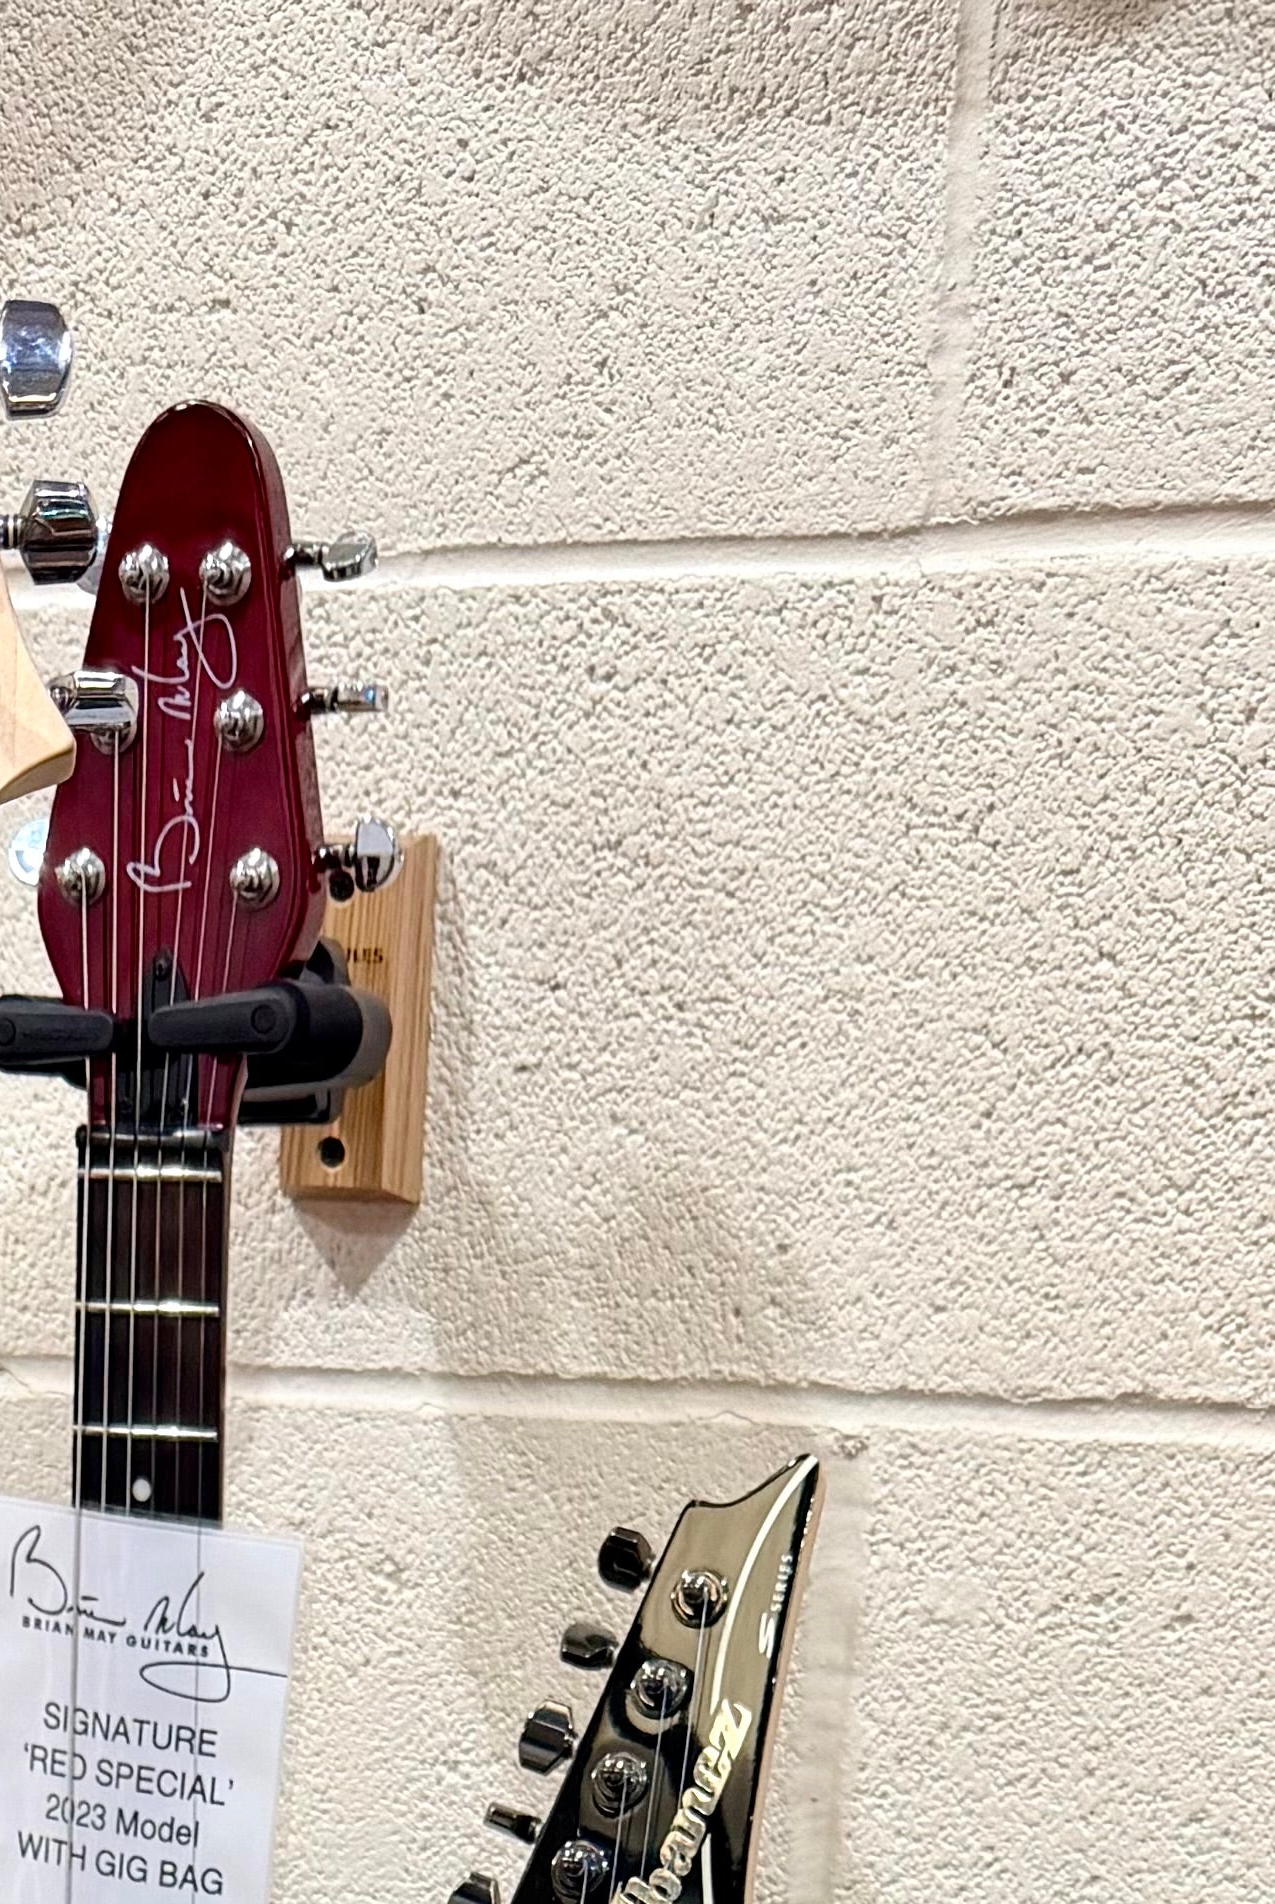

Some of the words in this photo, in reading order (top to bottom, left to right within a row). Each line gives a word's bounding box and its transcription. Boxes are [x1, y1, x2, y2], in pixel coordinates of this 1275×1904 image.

[770, 1553, 793, 1612] SERIES
[22, 1615, 75, 1637] BRIAN
[83, 1626, 117, 1645] MAY
[126, 1635, 210, 1658] GUITARS
[43, 1702, 218, 1758] SIGNATURE
[45, 1793, 107, 1831] 2023
[116, 1807, 200, 1848] Model
[18, 1830, 87, 1872] WITH
[95, 1849, 148, 1884] GIG
[158, 1860, 223, 1896] BAG
